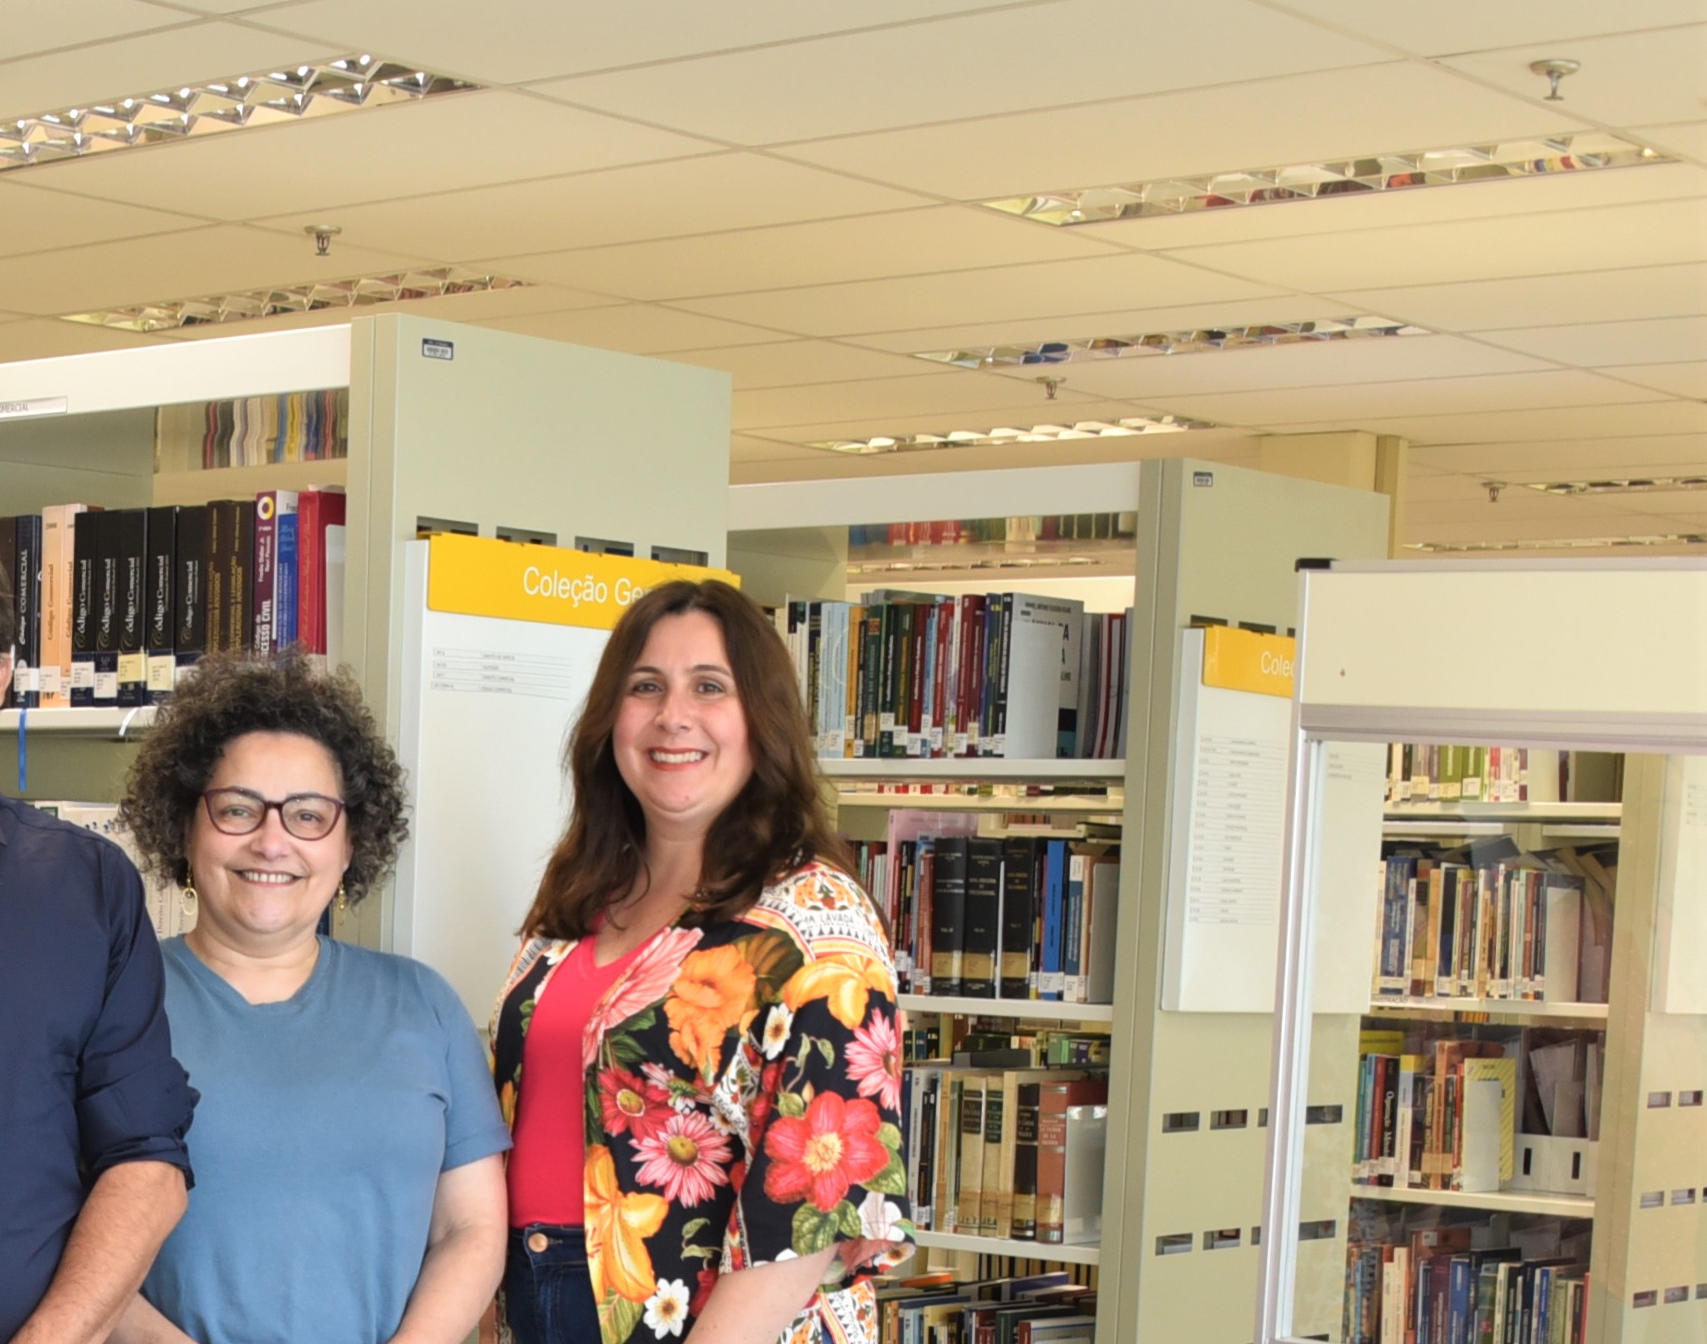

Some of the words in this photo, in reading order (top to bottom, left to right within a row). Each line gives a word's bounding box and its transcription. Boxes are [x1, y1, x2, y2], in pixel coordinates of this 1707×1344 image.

[20, 548, 28, 613] COMERCIAL
[523, 566, 608, 608] Coleção
[261, 599, 271, 622] CIVIL
